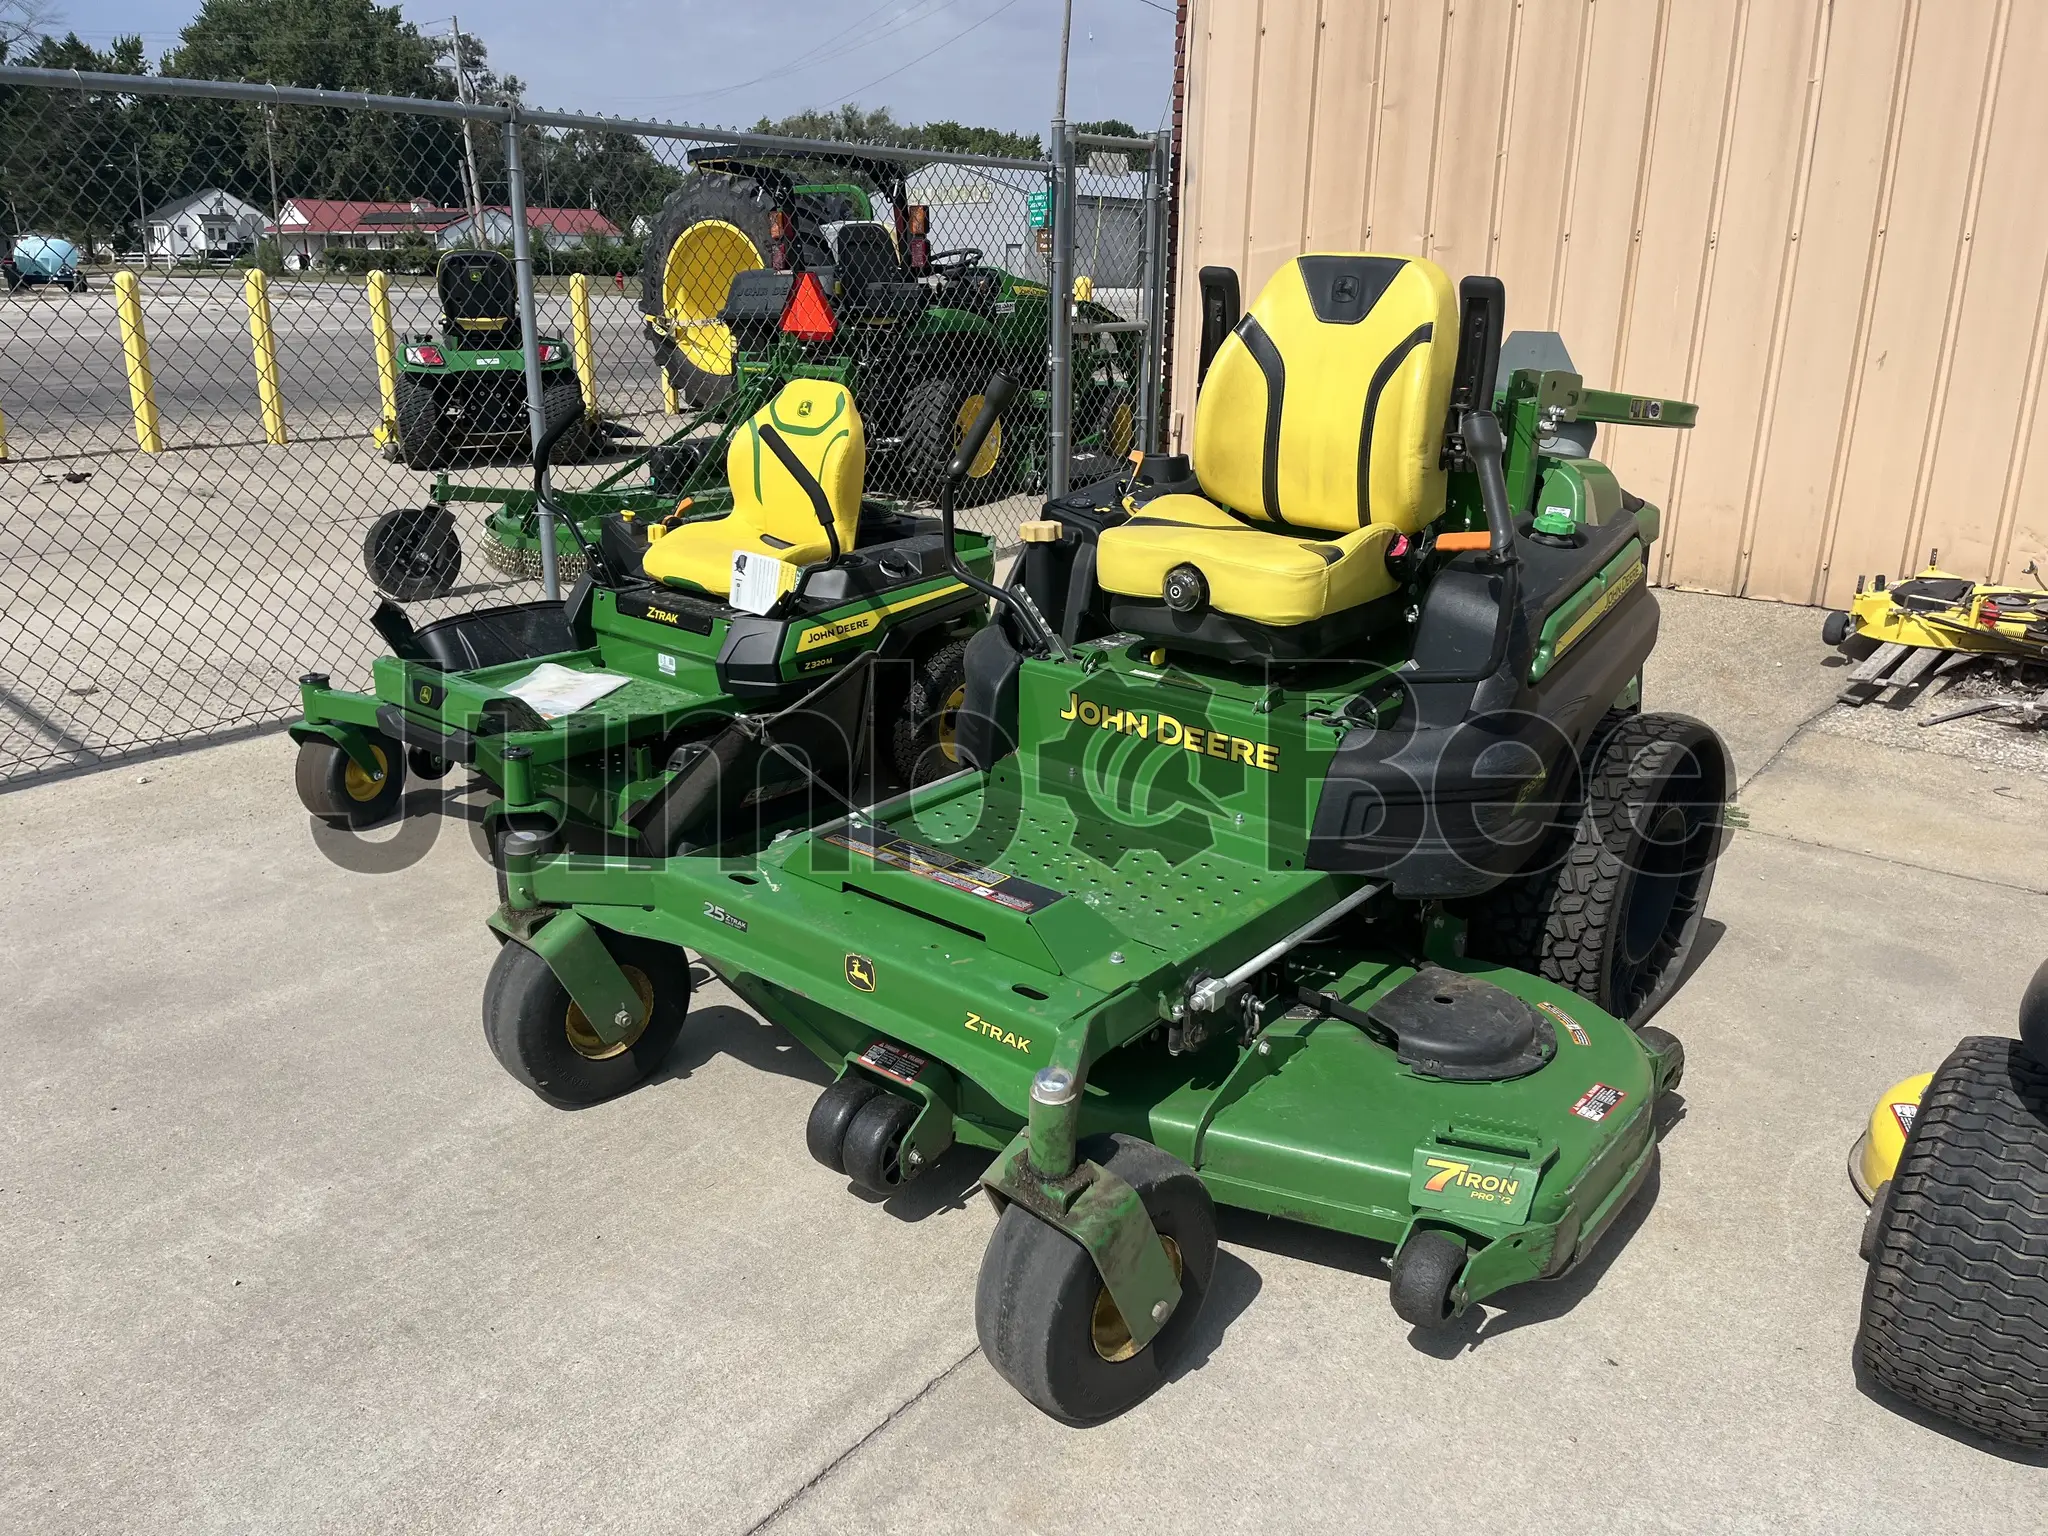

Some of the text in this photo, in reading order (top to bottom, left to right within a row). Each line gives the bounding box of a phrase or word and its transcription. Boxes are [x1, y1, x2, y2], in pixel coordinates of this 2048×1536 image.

[646, 606, 679, 624] ZTRAK
[807, 618, 869, 644] JOHN DEERE
[804, 657, 833, 670] Z320M
[1060, 692, 1280, 773] JOHN DEERE
[703, 900, 725, 922] 25
[964, 1011, 1032, 1054] ZTRAK
[1470, 1191, 1495, 1202] PRO
